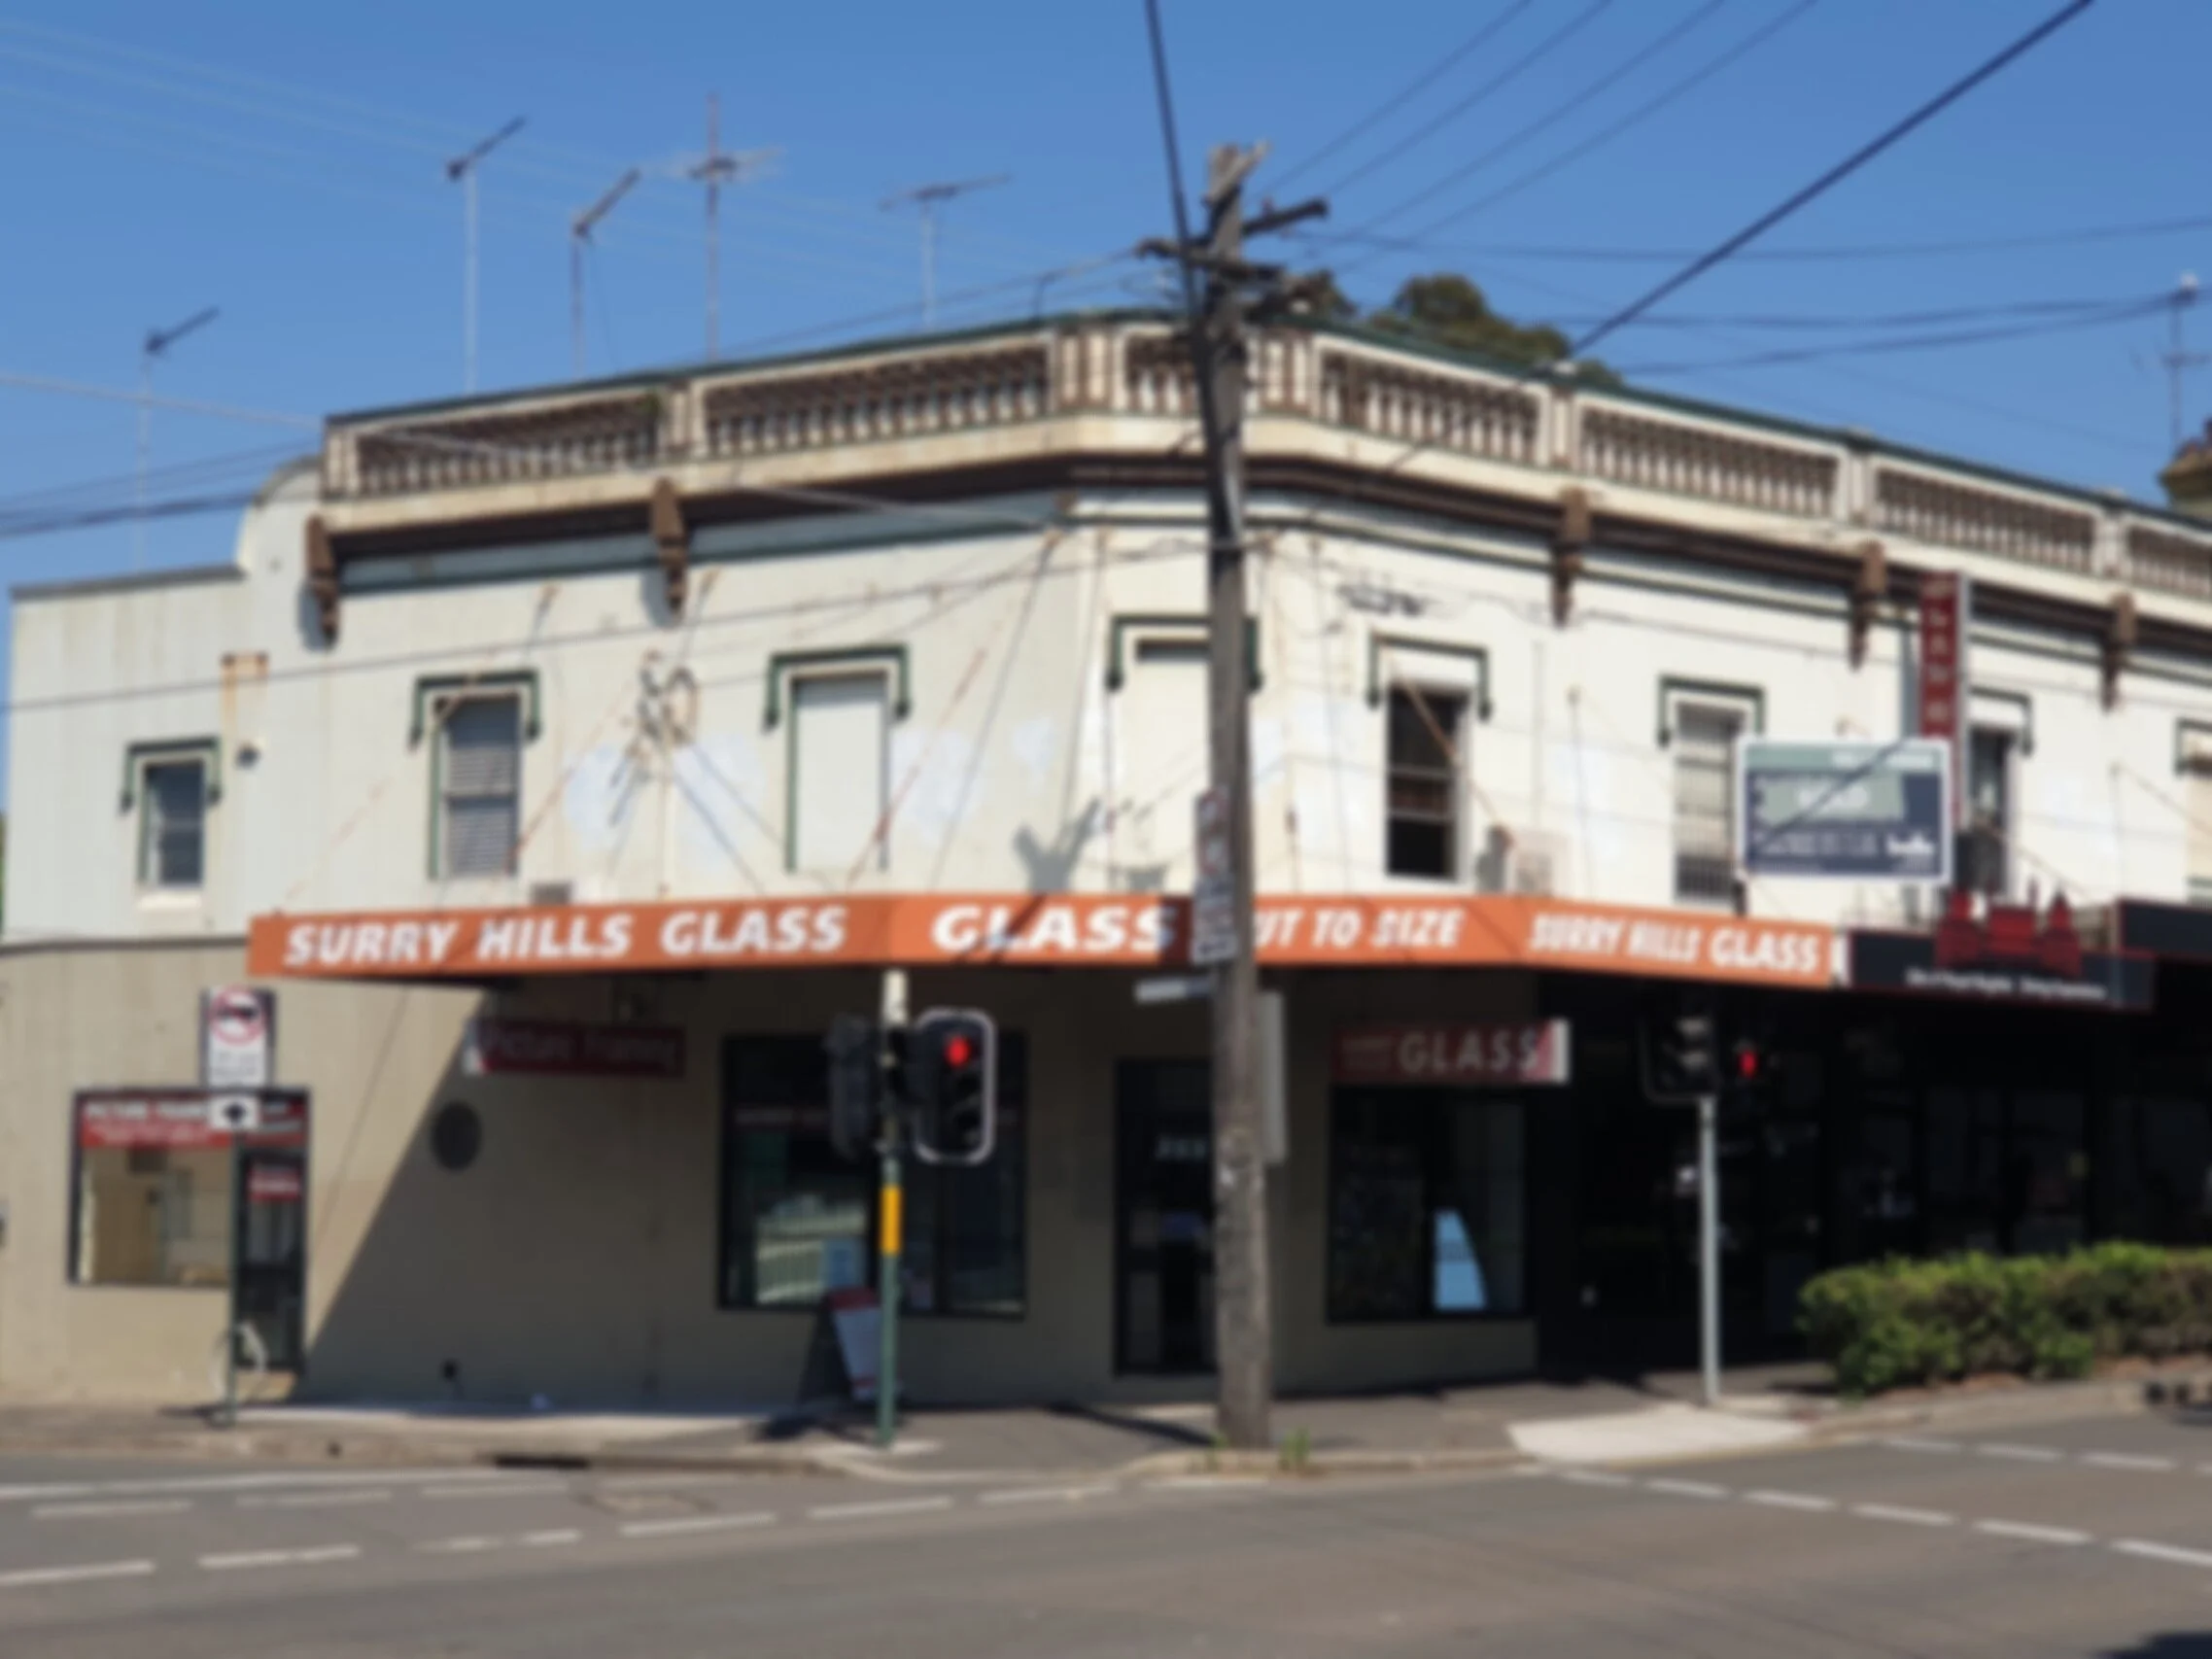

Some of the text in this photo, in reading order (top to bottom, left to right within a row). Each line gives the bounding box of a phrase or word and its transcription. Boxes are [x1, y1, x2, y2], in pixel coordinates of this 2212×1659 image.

[284, 906, 848, 968] SURRY HILLS GLASS
[931, 905, 1178, 953] GLASS
[1256, 907, 1303, 950] UT
[1312, 907, 1362, 950] TO
[1372, 907, 1465, 950] SIZE
[1531, 913, 1819, 973] SURRY HILLS GLASS
[1399, 1030, 1538, 1073] GLASS
